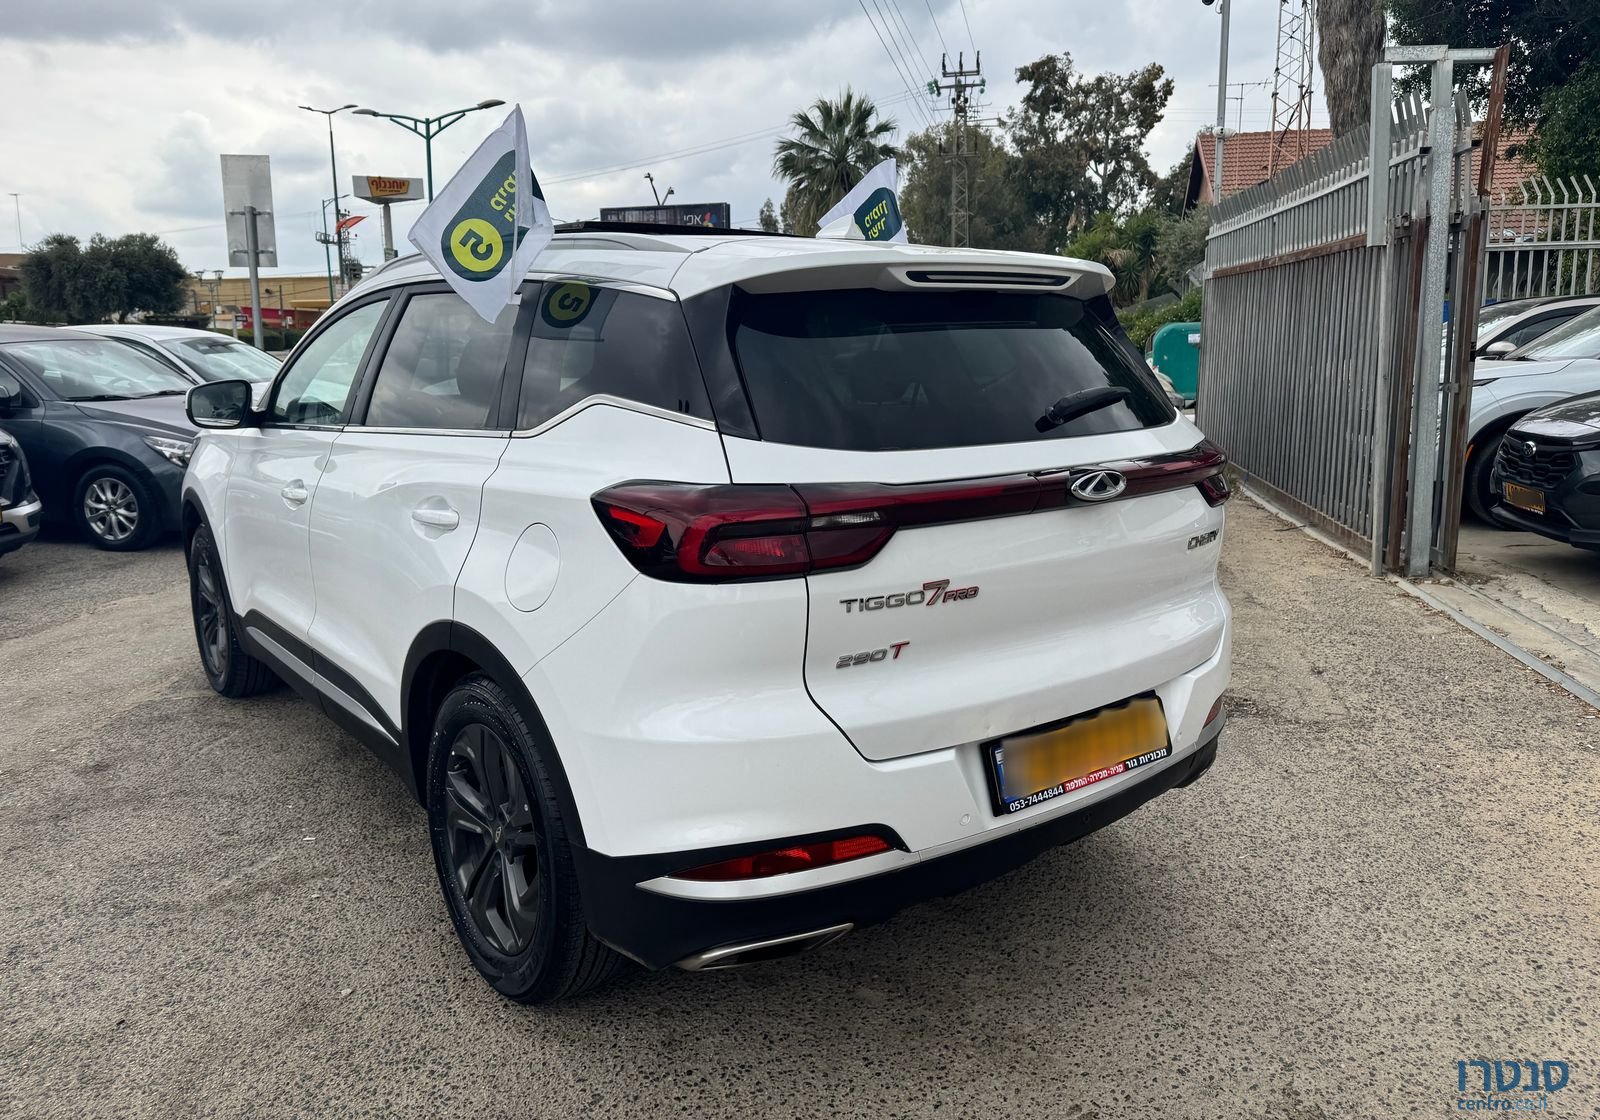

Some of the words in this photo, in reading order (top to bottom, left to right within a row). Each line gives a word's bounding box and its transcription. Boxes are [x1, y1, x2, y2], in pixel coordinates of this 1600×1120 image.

[1125, 760, 1138, 769] גור
[1139, 748, 1168, 765] מכוניות
[1009, 785, 1064, 812] 053-7444844
